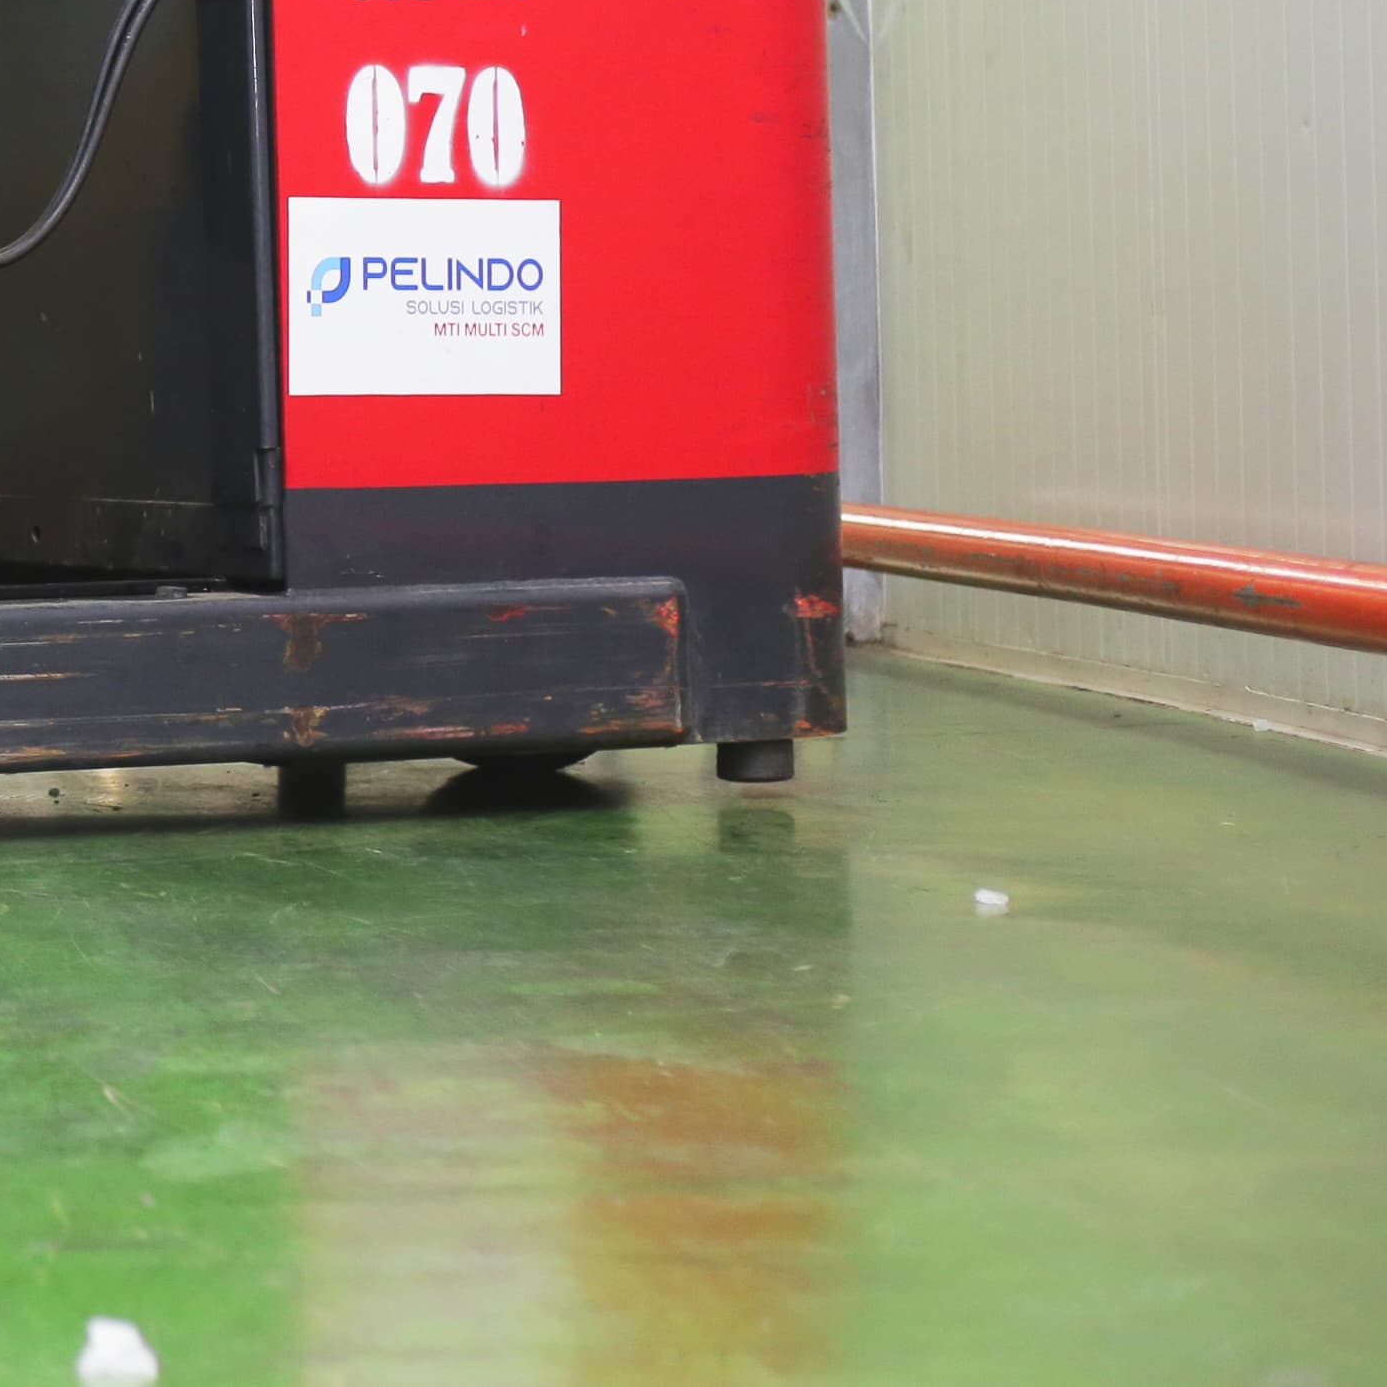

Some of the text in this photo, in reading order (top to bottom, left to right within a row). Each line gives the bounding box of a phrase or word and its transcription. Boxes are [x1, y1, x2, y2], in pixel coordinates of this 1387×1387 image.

[345, 64, 527, 187] 070
[362, 256, 544, 292] PELINDO
[405, 300, 544, 315] SOLUSI LOGISTIK
[434, 322, 545, 337] MTI MULTI SCM
